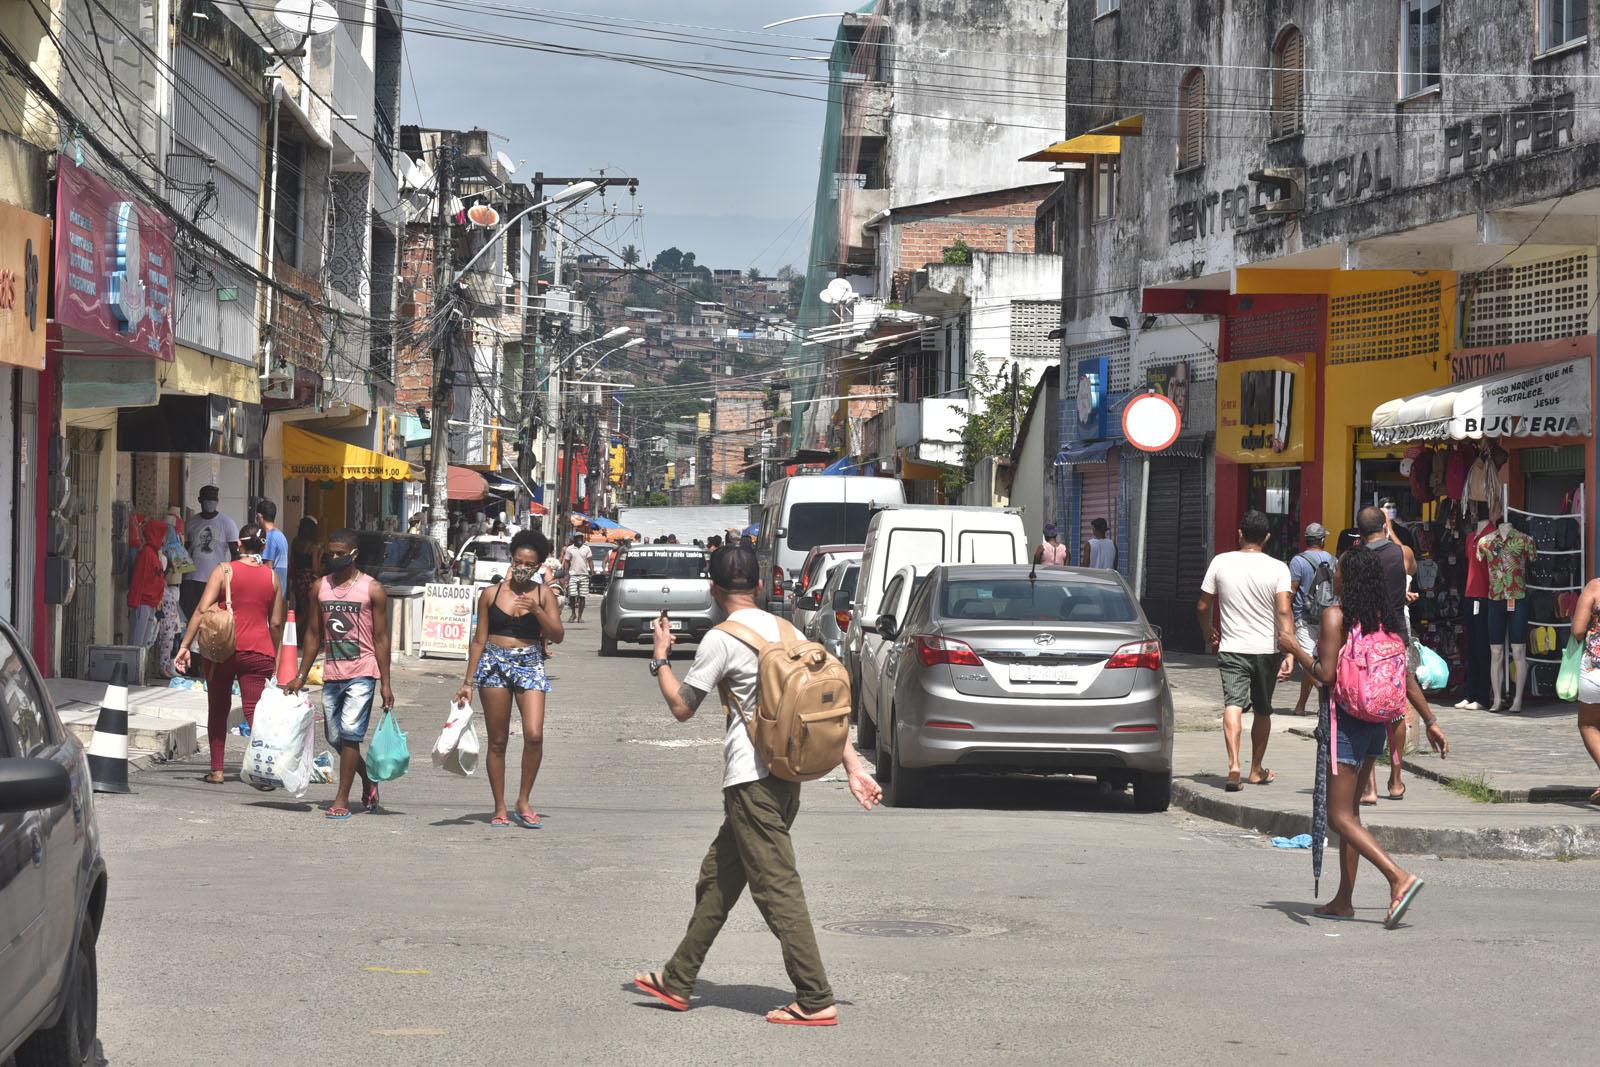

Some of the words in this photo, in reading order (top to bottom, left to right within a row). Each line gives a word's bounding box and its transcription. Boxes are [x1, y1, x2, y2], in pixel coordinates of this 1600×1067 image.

[1168, 185, 1248, 244] CENTRO
[1451, 351, 1506, 384] SANTIAGO
[1511, 375, 1543, 391] NAQUELE
[1544, 369, 1560, 382] QUE
[1562, 364, 1574, 376] ME
[1533, 396, 1560, 409] JESUS
[347, 466, 360, 474] VIVA
[361, 466, 367, 474] O
[427, 586, 470, 599] SALGADOS
